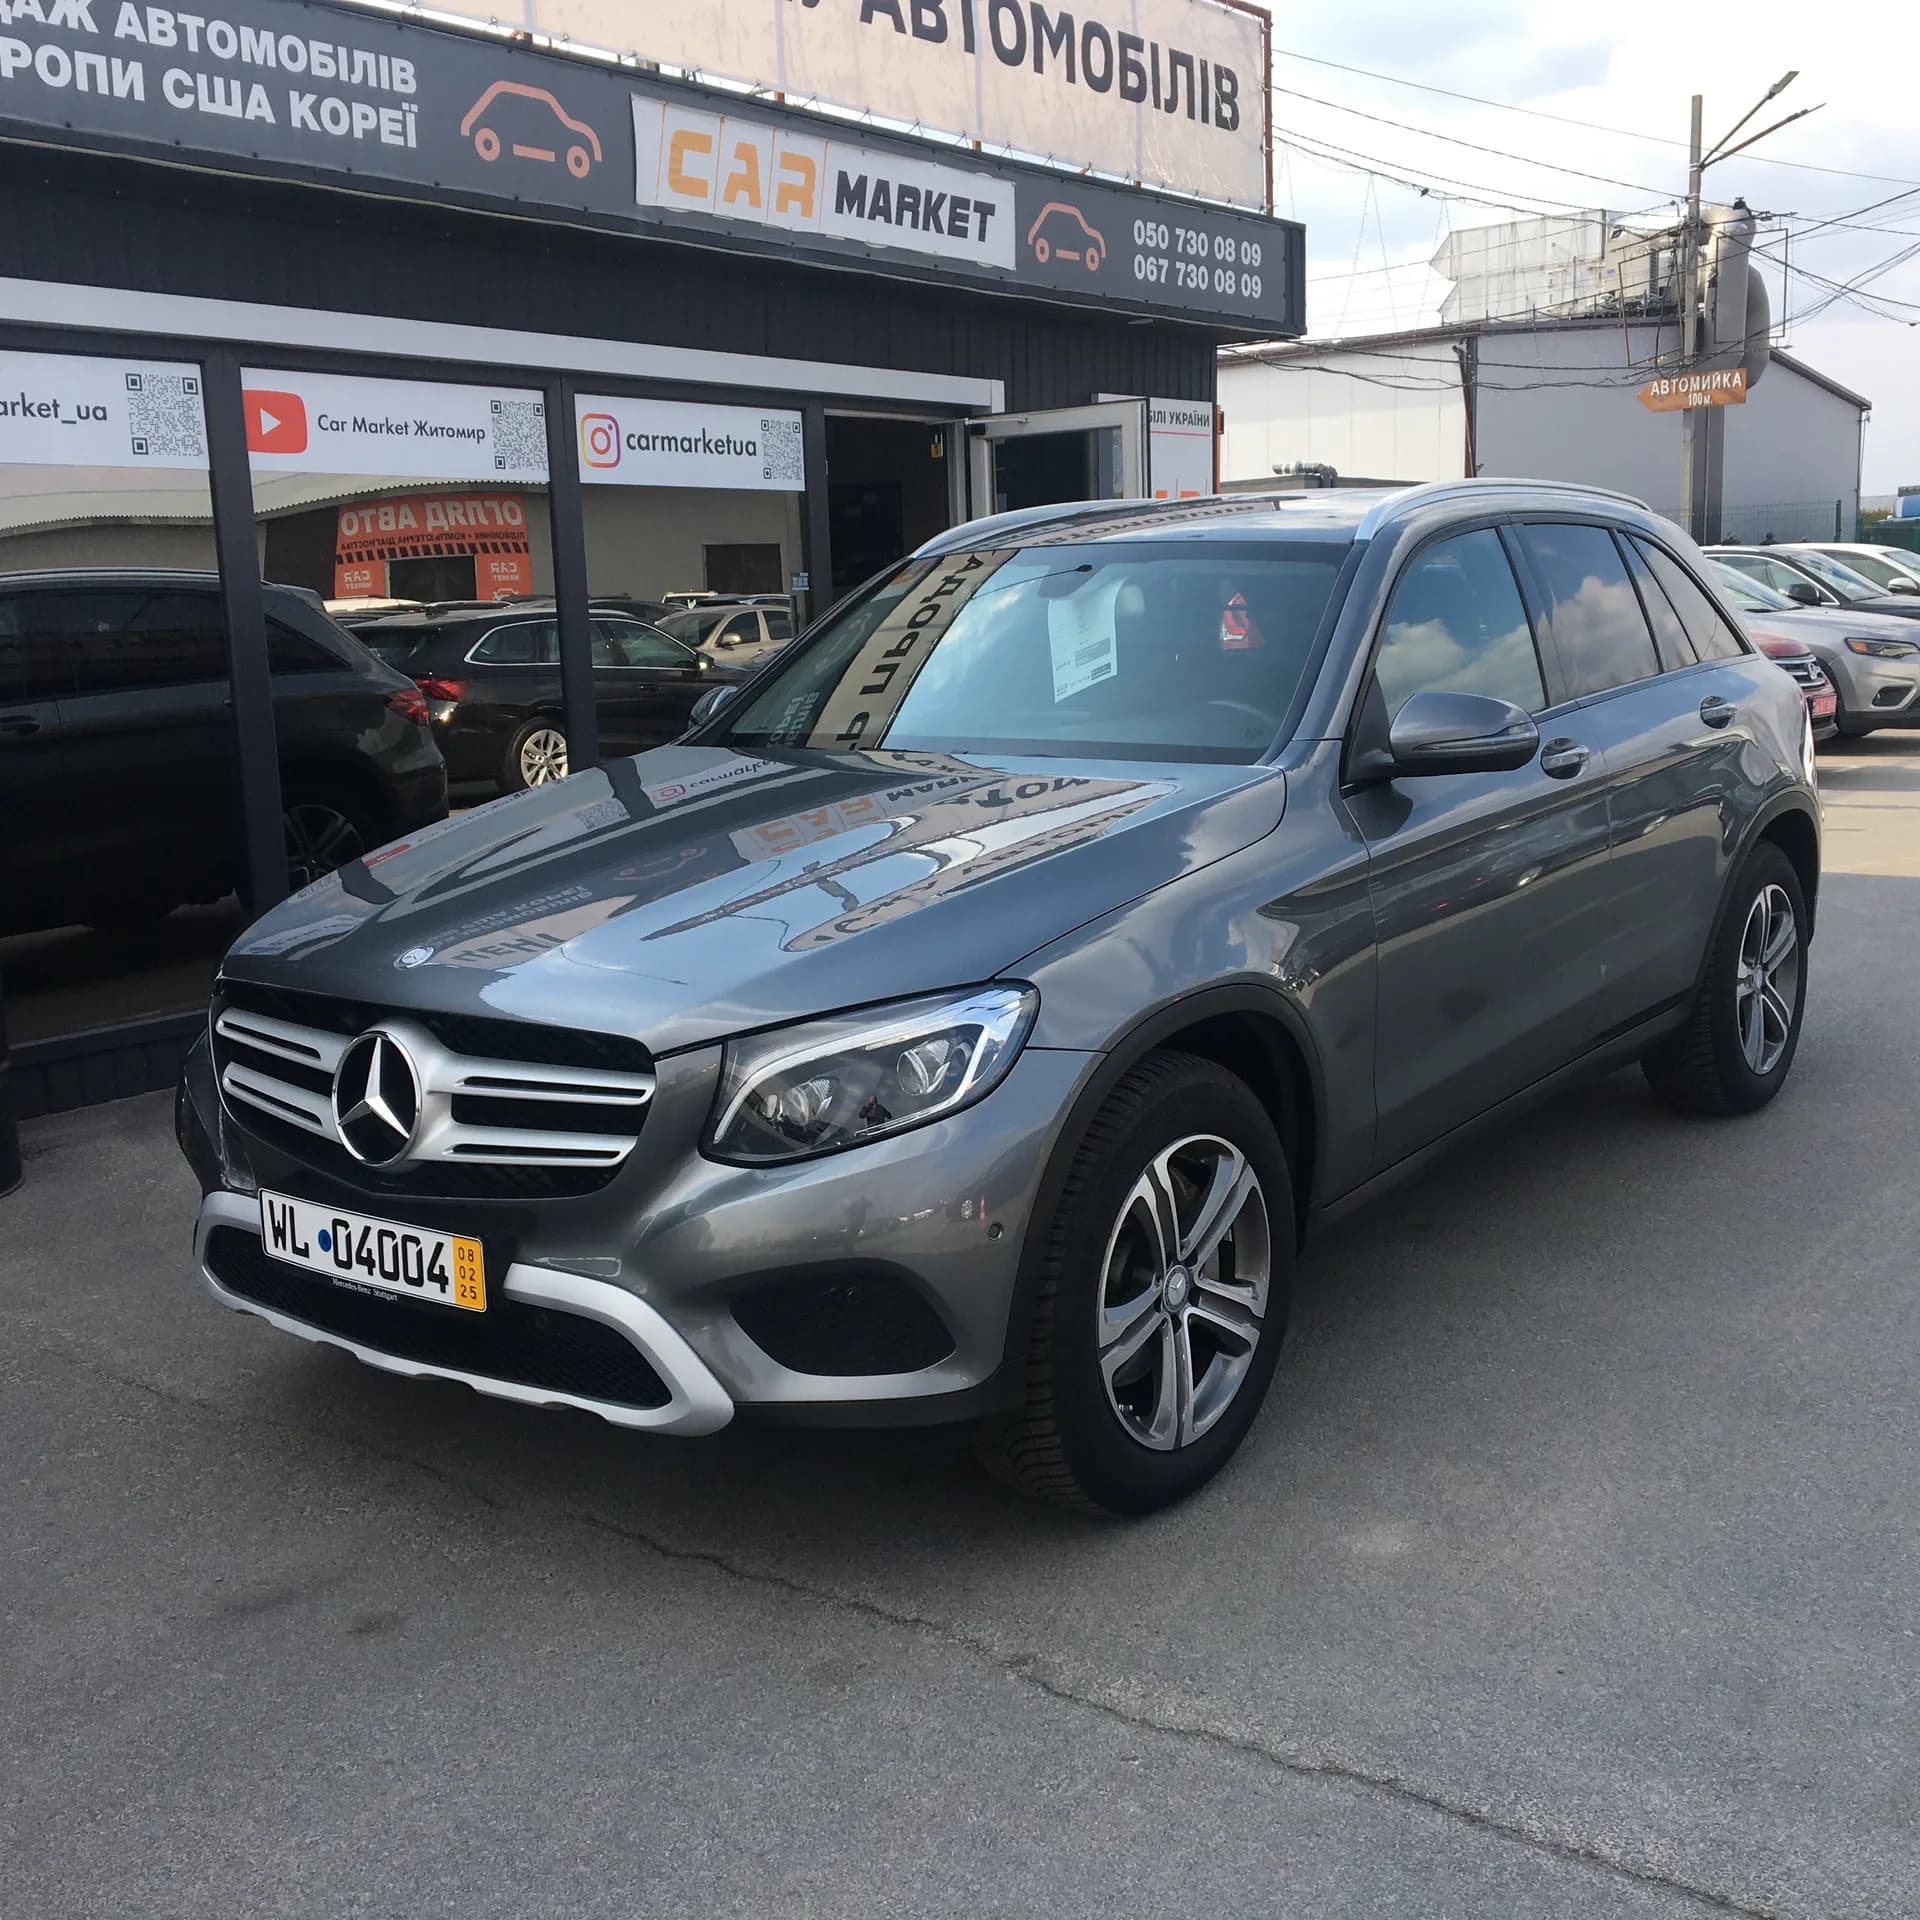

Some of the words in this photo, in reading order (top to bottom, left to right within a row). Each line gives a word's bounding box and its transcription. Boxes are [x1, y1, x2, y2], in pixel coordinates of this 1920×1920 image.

[0, 0, 100, 33] АЖ
[114, 1, 417, 95] АВТОМОБІЛІВ
[0, 36, 145, 101] РОПИ
[162, 67, 276, 125] США
[289, 89, 419, 149] КОРЕЇ
[668, 129, 816, 219] CAR
[834, 169, 996, 243] MARKET
[1133, 219, 1169, 250] 050
[1175, 227, 1208, 257] 730
[1214, 235, 1236, 262] 08
[1241, 241, 1261, 267] 09
[1133, 254, 1168, 284] 067
[1175, 261, 1208, 290] 730
[1214, 268, 1236, 295] 08
[1241, 273, 1261, 299] 09
[1650, 371, 1742, 396] АВТОМИЙКА
[0, 391, 108, 425] arket_ua
[1169, 410, 1210, 427] УКРАЇНИ
[317, 414, 347, 432] Car
[352, 416, 409, 436] Market
[413, 419, 486, 444] Житомир
[626, 427, 757, 457] carmarketua
[268, 1199, 310, 1259] WL
[332, 1217, 450, 1294] 04004
[458, 1247, 475, 1262] 08
[459, 1267, 476, 1282] 02
[460, 1284, 478, 1300] 25
